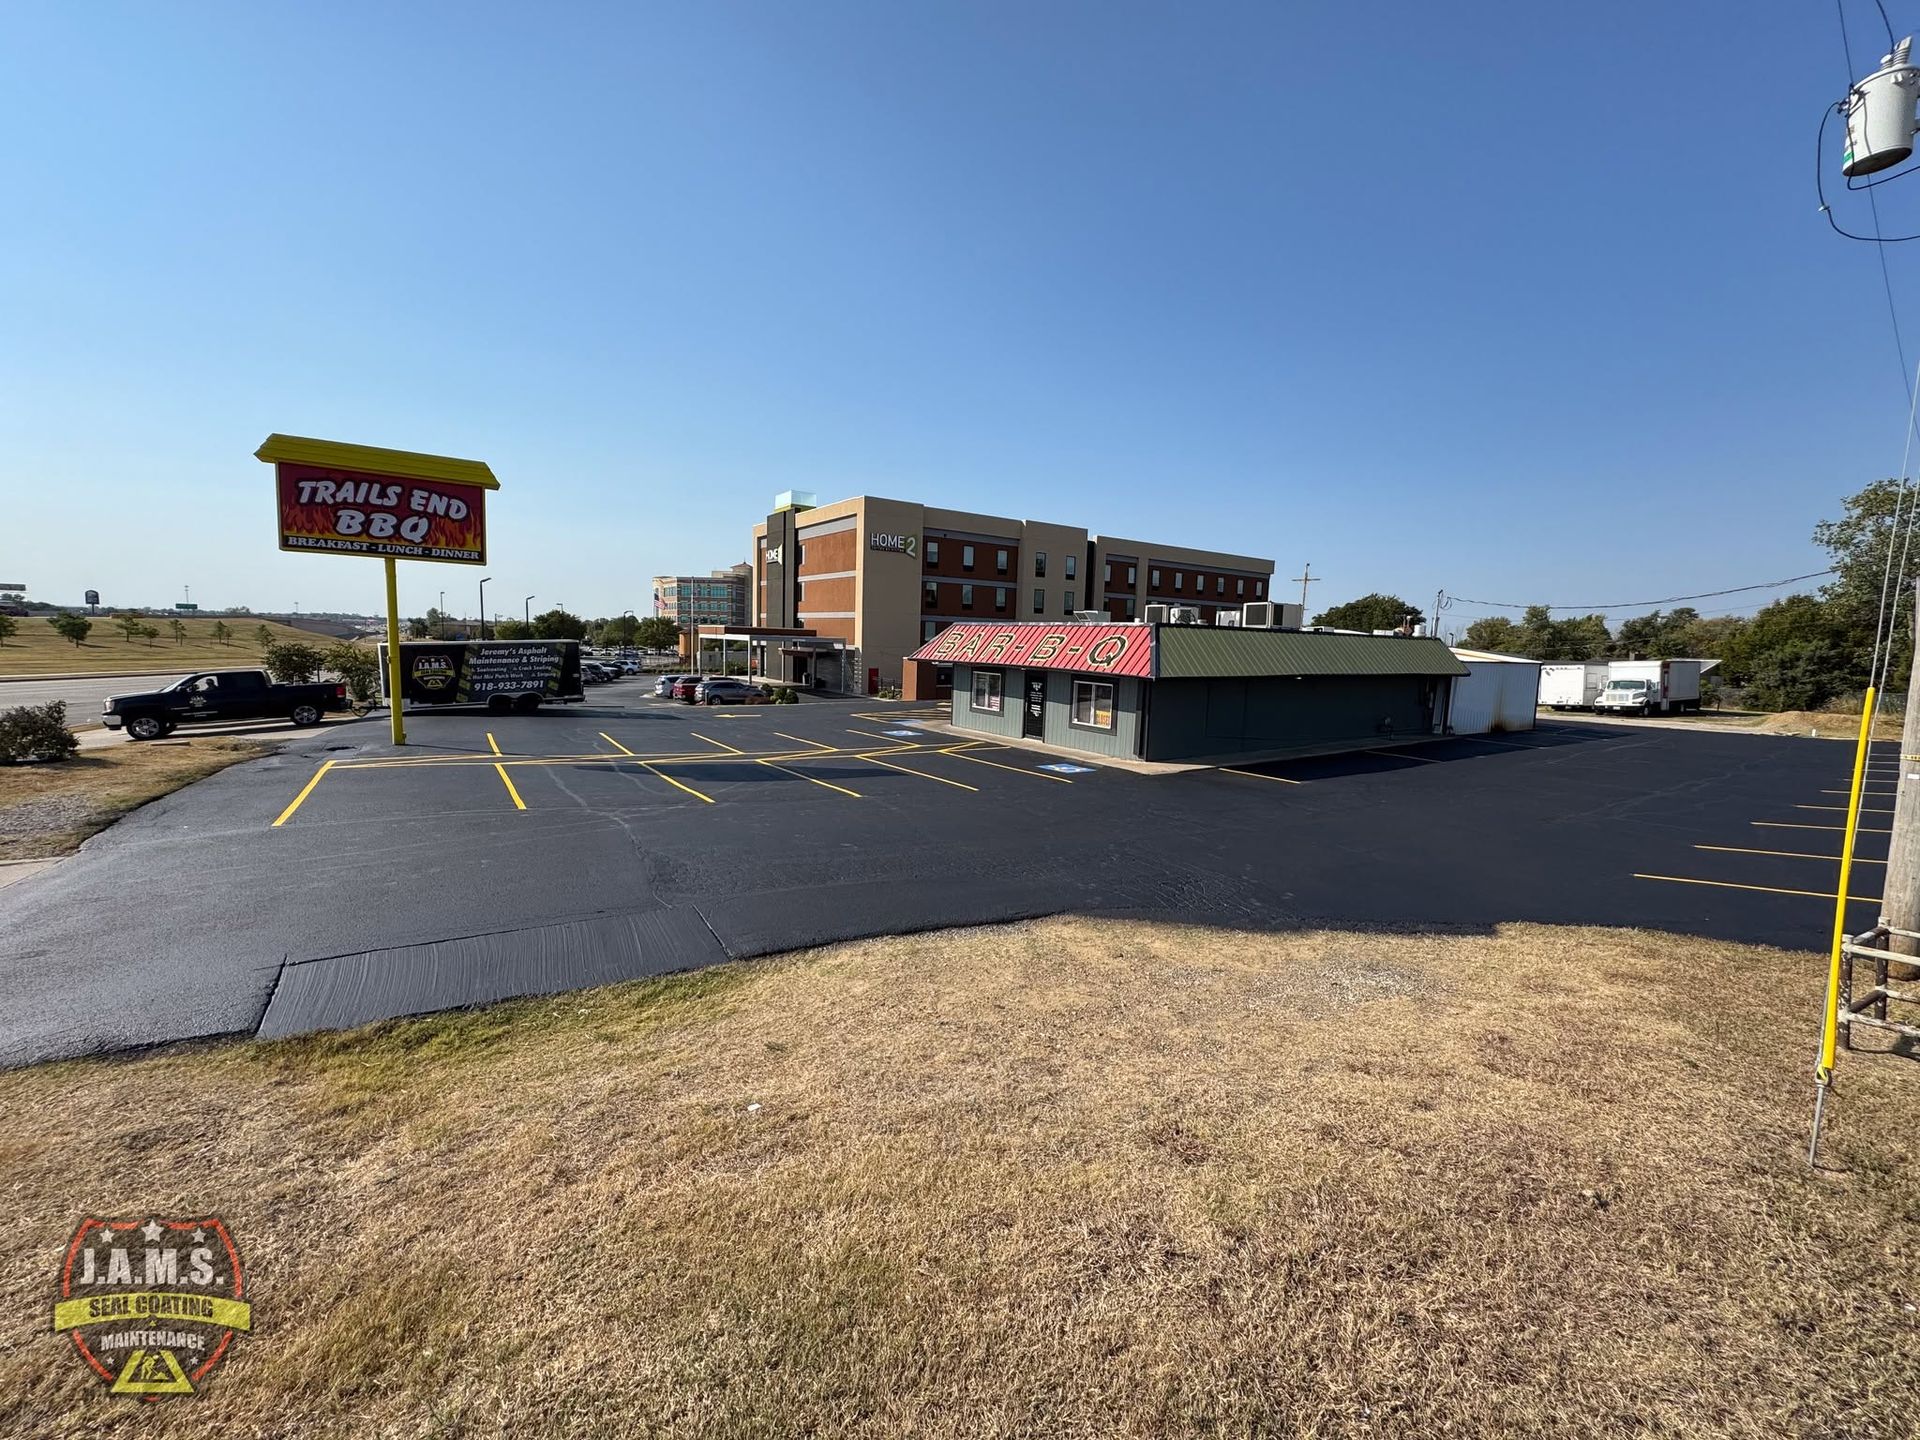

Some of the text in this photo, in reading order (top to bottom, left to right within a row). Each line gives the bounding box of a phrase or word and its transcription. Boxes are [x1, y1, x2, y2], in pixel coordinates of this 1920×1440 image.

[298, 480, 468, 520] TRAILS END
[335, 509, 430, 544] BBQ
[287, 536, 370, 551] BREAKFAST
[378, 544, 423, 555] LUNCH
[431, 549, 480, 560] DINNER
[469, 657, 520, 665] Maintenance
[529, 655, 559, 663] Striping
[480, 646, 548, 656] Jeremy's Asphalt
[935, 631, 1129, 668] BAR-B-Q
[474, 680, 544, 691] 918-933-7891
